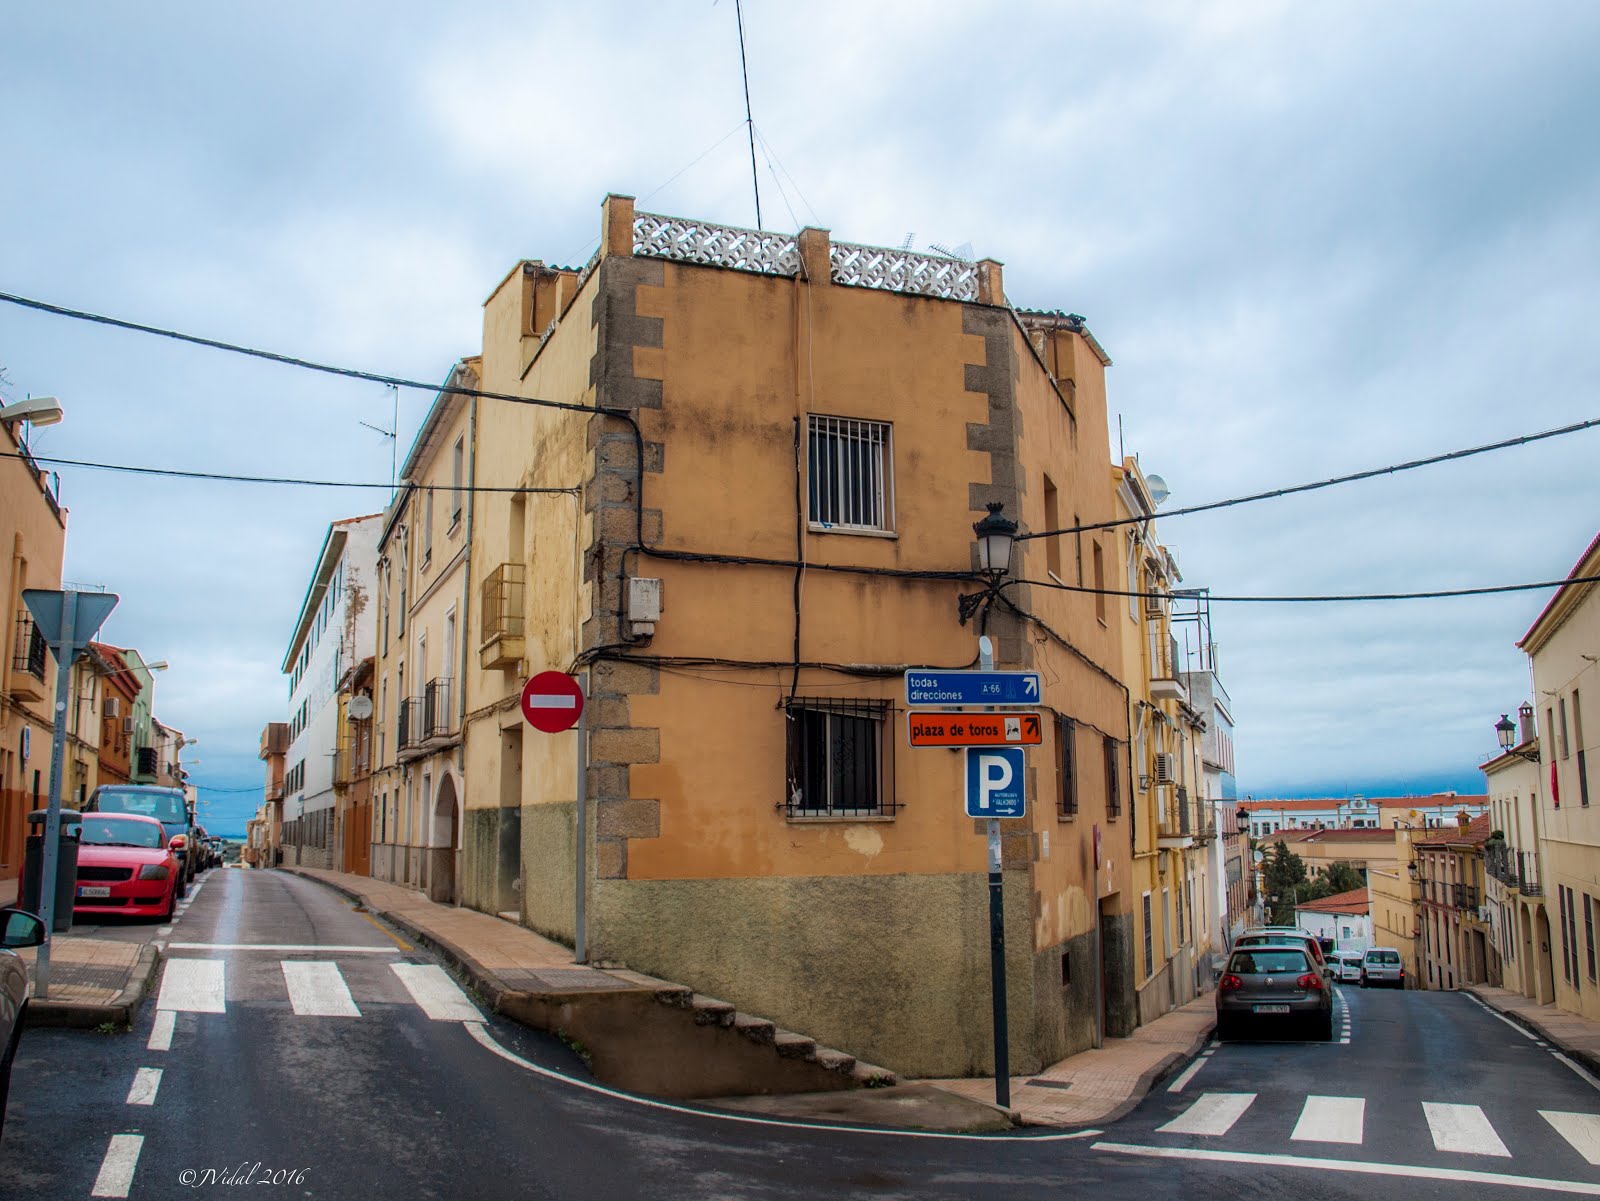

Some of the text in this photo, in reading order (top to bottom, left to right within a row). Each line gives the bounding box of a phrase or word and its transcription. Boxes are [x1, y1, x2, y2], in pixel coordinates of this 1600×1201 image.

[910, 677, 938, 688] todas
[910, 689, 963, 700] direcciones
[912, 723, 999, 740] plaza de toros
[979, 755, 1013, 809] P
